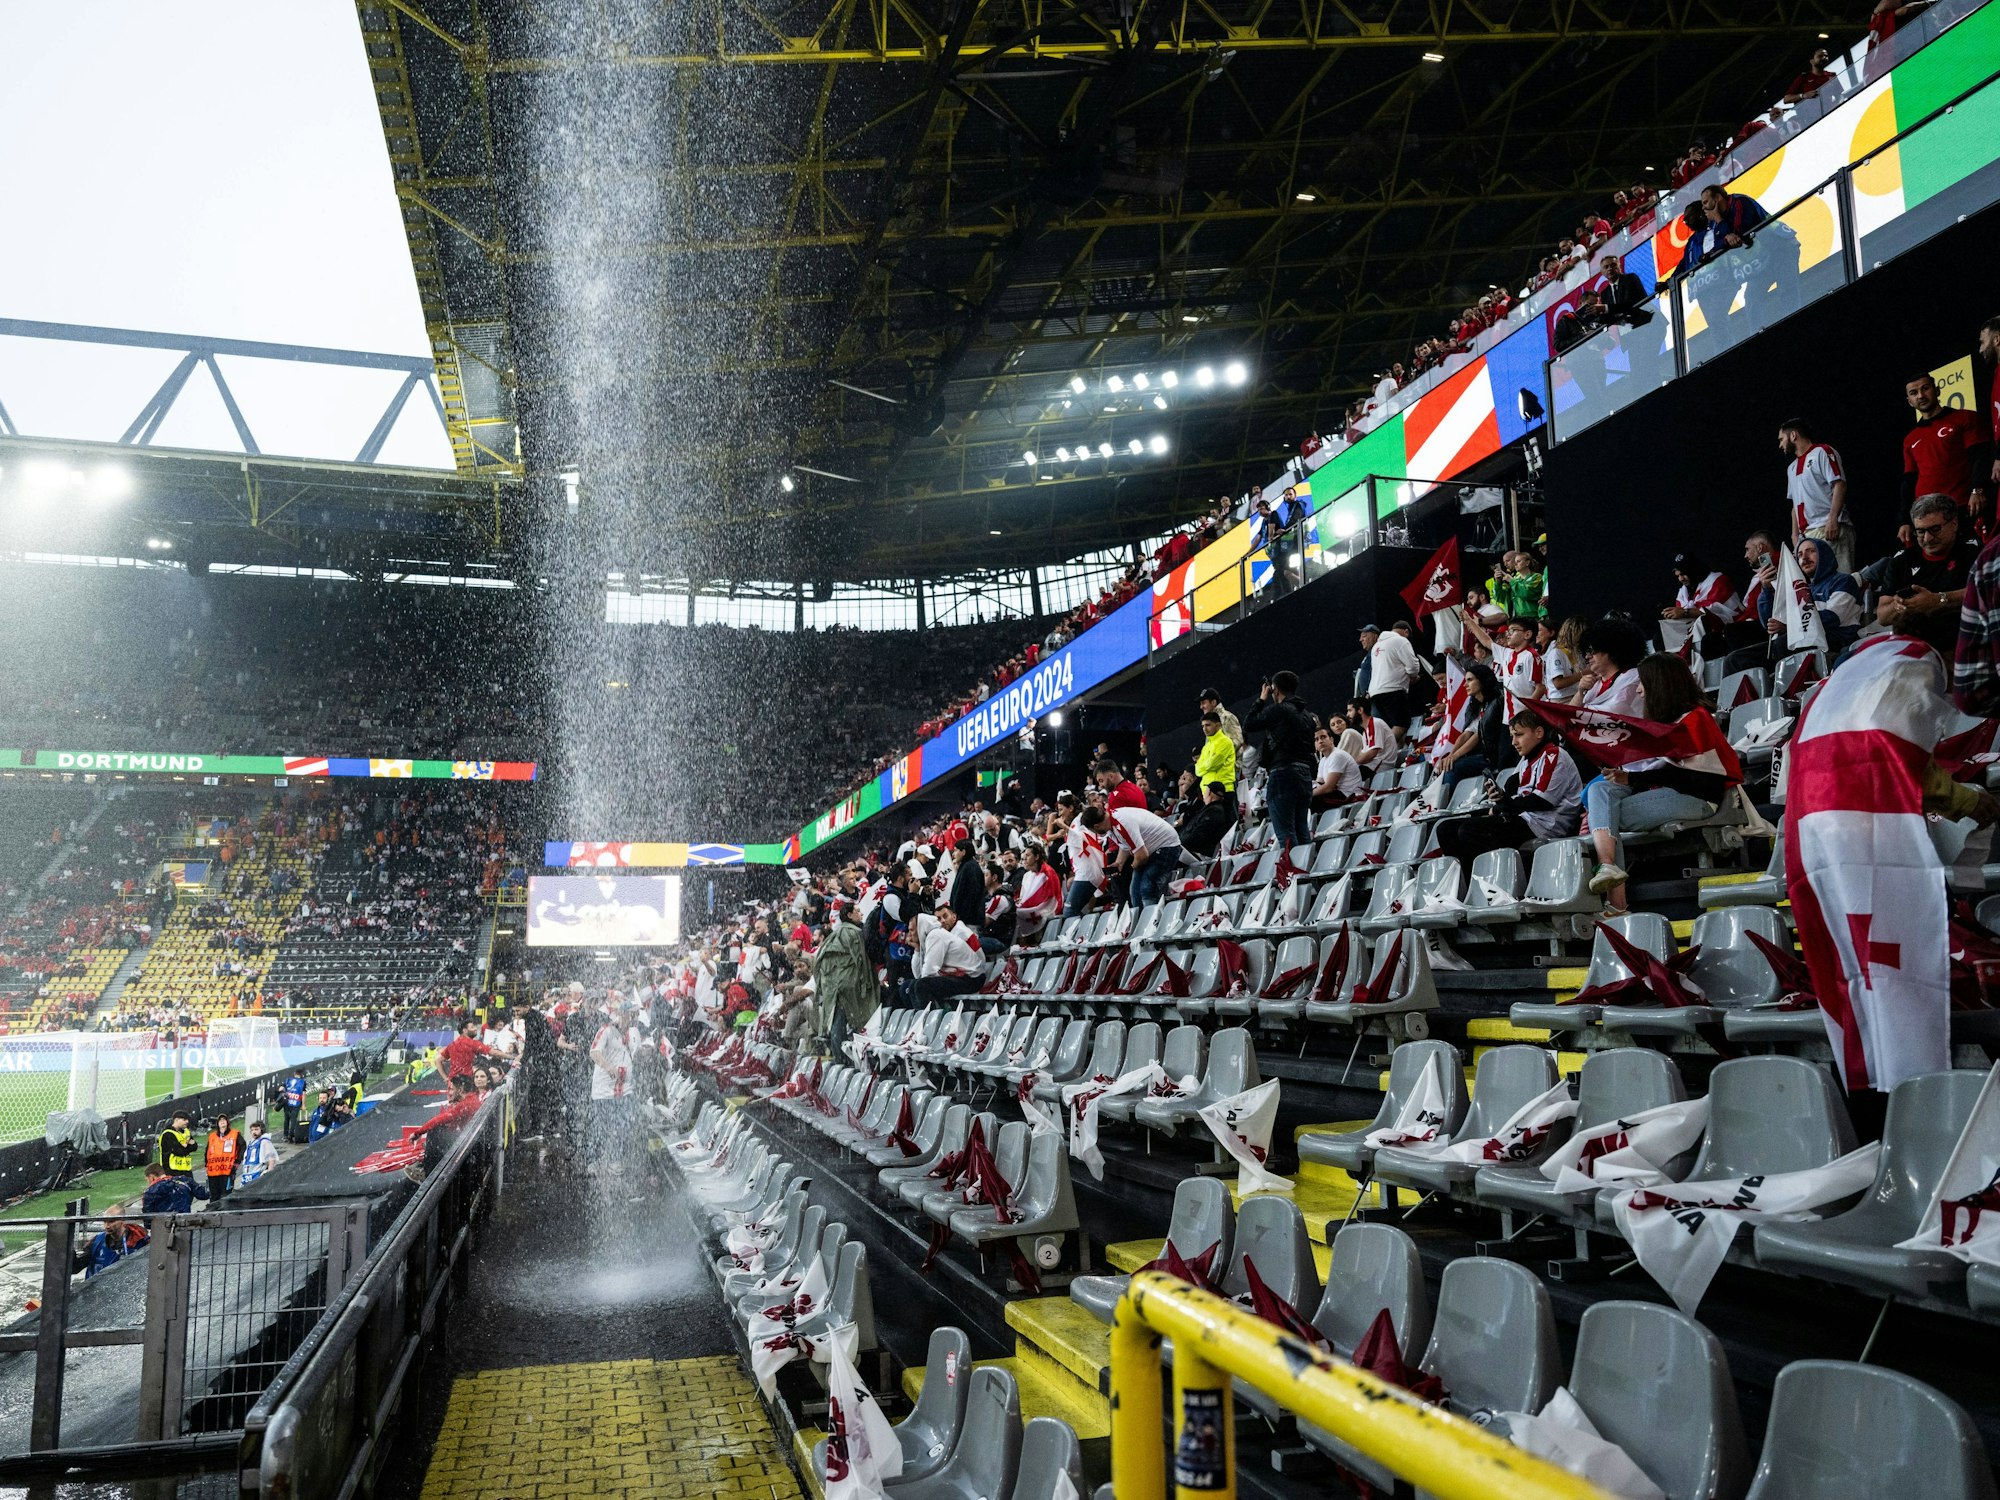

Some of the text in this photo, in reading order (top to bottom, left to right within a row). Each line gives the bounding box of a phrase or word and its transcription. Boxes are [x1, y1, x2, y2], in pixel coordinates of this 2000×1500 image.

[1937, 369, 1965, 389] OCK
[58, 752, 204, 771] DORTMUND
[1581, 924, 1588, 932] 5
[1415, 1024, 1421, 1032] 4
[122, 1048, 267, 1069] visit QATAR
[1045, 1250, 1052, 1260] 2
